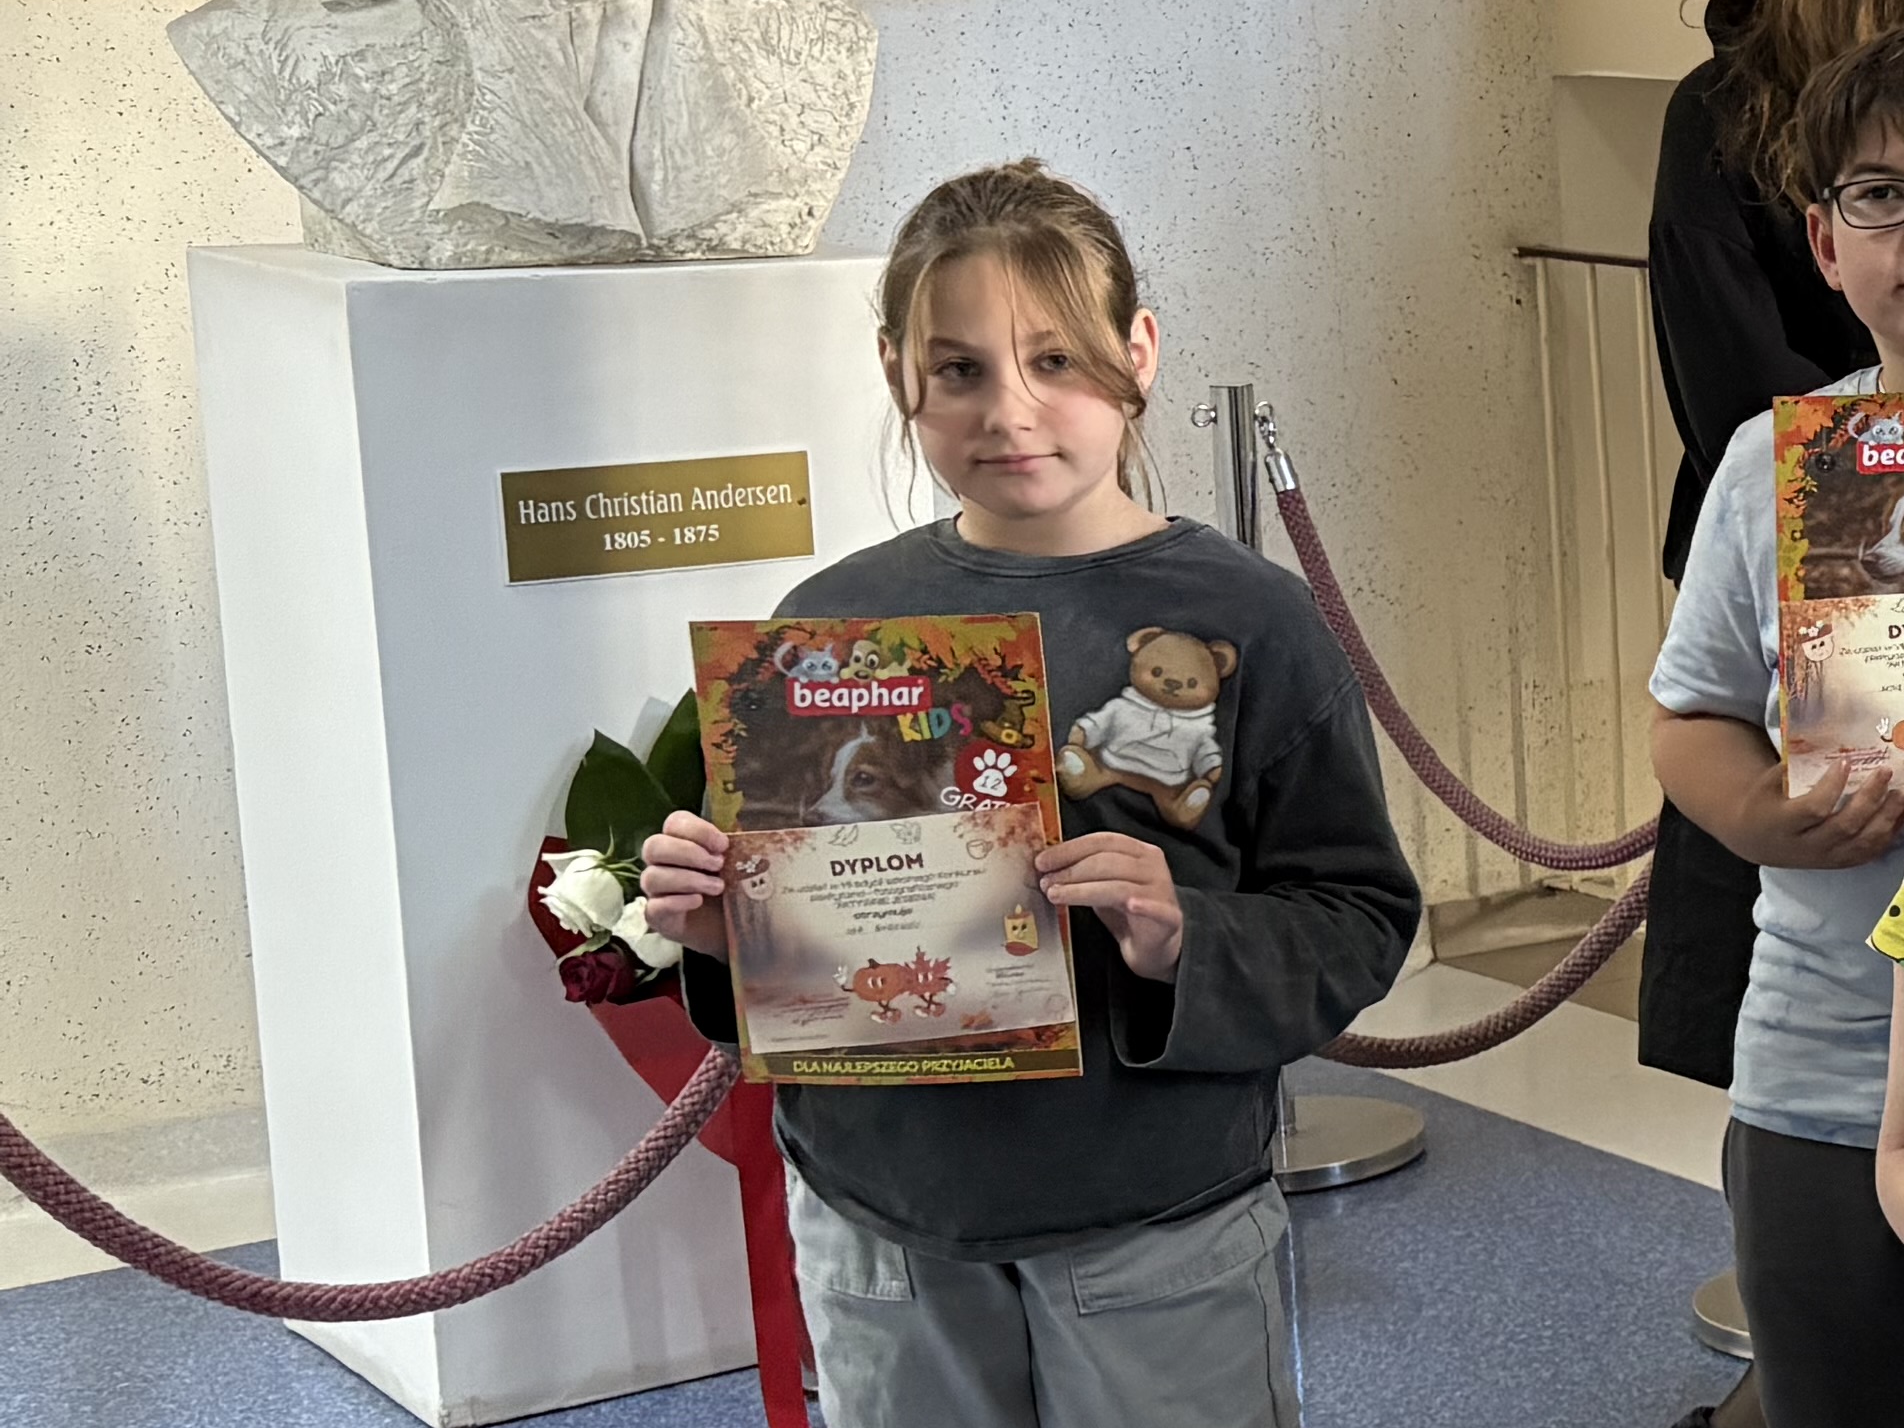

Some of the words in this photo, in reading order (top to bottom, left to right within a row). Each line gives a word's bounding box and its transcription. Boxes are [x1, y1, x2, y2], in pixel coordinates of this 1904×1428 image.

[518, 499, 577, 524] Hans
[585, 491, 683, 520] Christian
[691, 483, 792, 511] Andersen
[603, 530, 651, 551] 1805
[673, 524, 720, 546] 1875
[793, 680, 924, 713] beaphar
[898, 703, 971, 741] KIDS
[980, 775, 1002, 790] 12
[830, 853, 924, 876] DYPLOM
[793, 1060, 819, 1072] DLA
[822, 1060, 918, 1073] NAJLEPSZEGO
[921, 1057, 1015, 1072] PRZYJACIELA
